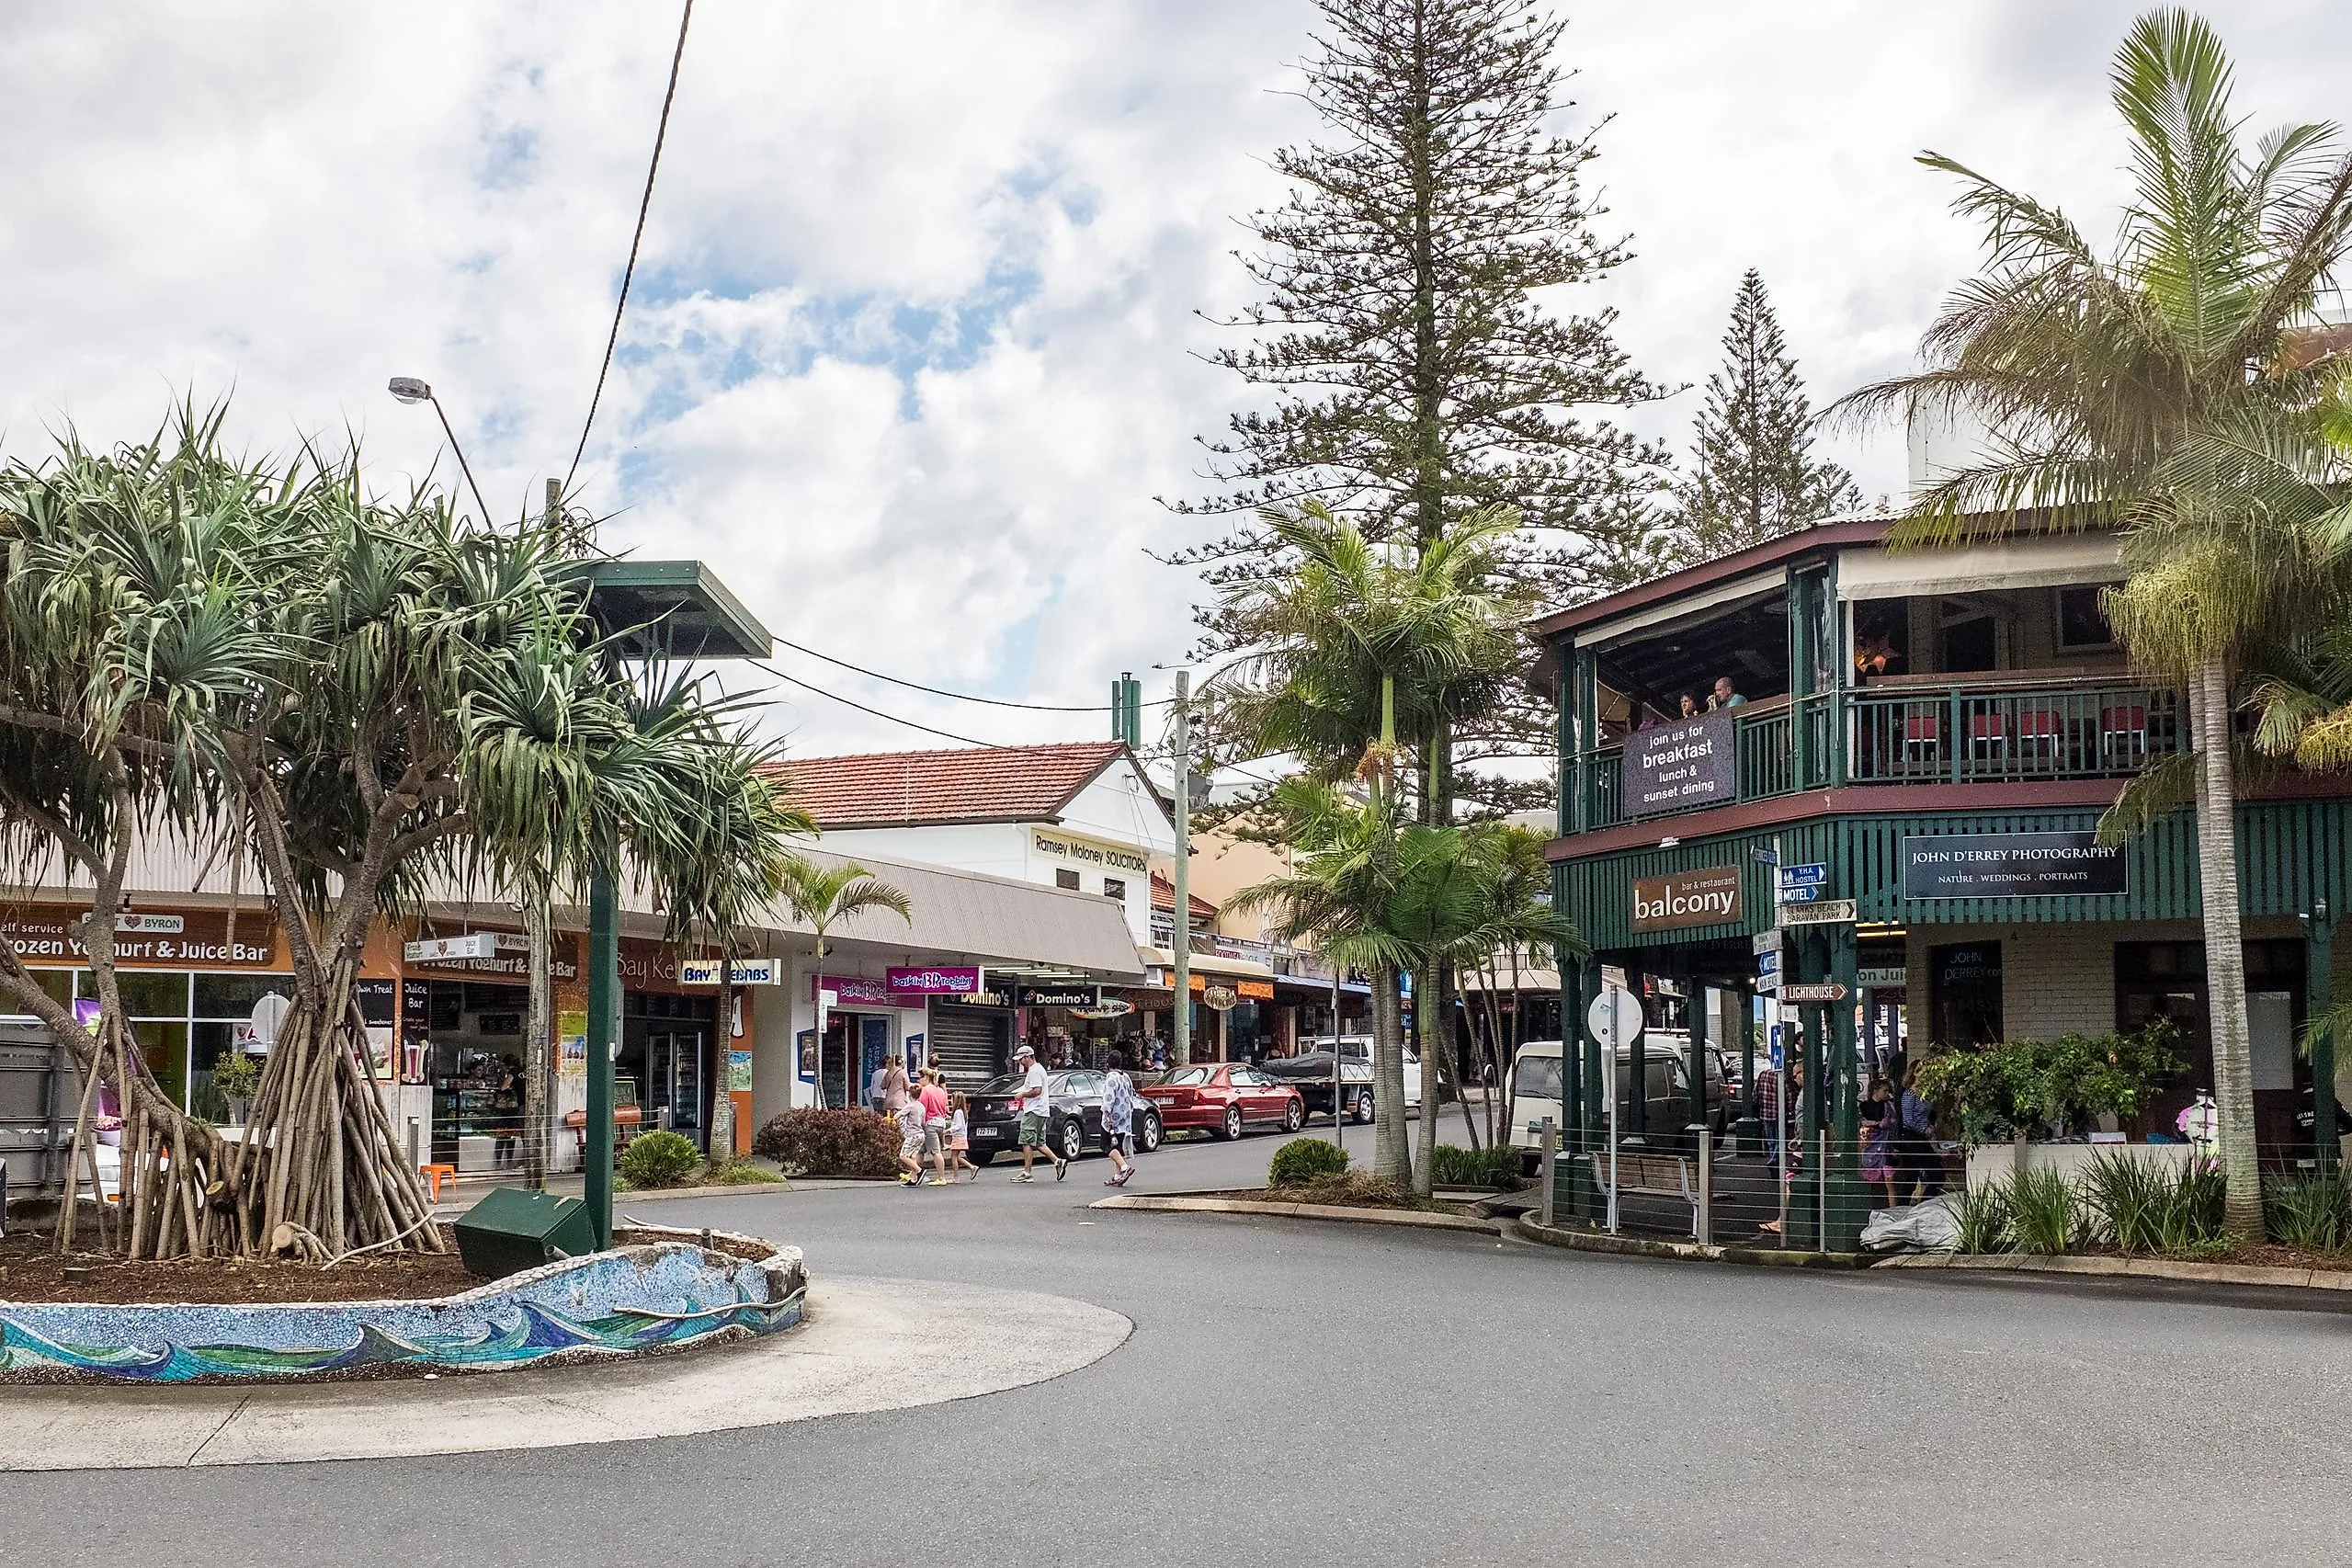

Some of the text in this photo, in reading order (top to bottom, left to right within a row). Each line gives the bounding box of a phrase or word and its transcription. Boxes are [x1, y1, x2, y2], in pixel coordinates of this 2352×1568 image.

[1649, 726, 1704, 749] join us for
[1642, 738, 1713, 768] breakfast
[1658, 764, 1698, 783] lunch &
[1643, 780, 1715, 802] sunset dining
[1036, 835, 1146, 872] Ramsey Moloney SOLICITORS
[1912, 846, 2119, 866] JOHN D'ERREY PHOTOGRAPHY
[1795, 875, 1818, 884] HOSTEL
[1937, 869, 2088, 883] NATURE WEDDINGS PORTRAITS
[1681, 876, 1735, 891] bar & restaurant
[1634, 884, 1735, 919] balcony
[1783, 888, 1810, 902] MOTEL
[1818, 902, 1841, 913] BEACH
[144, 919, 180, 928] BYRON
[1787, 911, 1841, 923] CARAVAN PARK
[1, 923, 63, 934] elf service
[7, 939, 63, 955] ozen
[156, 940, 176, 958] &
[178, 941, 227, 960] Juice
[233, 943, 268, 961] Bar
[556, 960, 576, 977] Bar
[684, 967, 769, 982] BAY EBABS
[1858, 969, 1903, 981] on Jui
[892, 975, 923, 987] baskin
[941, 975, 971, 987] robbins
[373, 983, 393, 994] Treat
[404, 983, 427, 994] Juice
[840, 983, 863, 997] baskin
[1789, 986, 1835, 999] LIGHTHOUSE
[408, 997, 424, 1009] Bar
[1036, 993, 1091, 1005] Domino's
[1144, 999, 1175, 1009] HOUS
